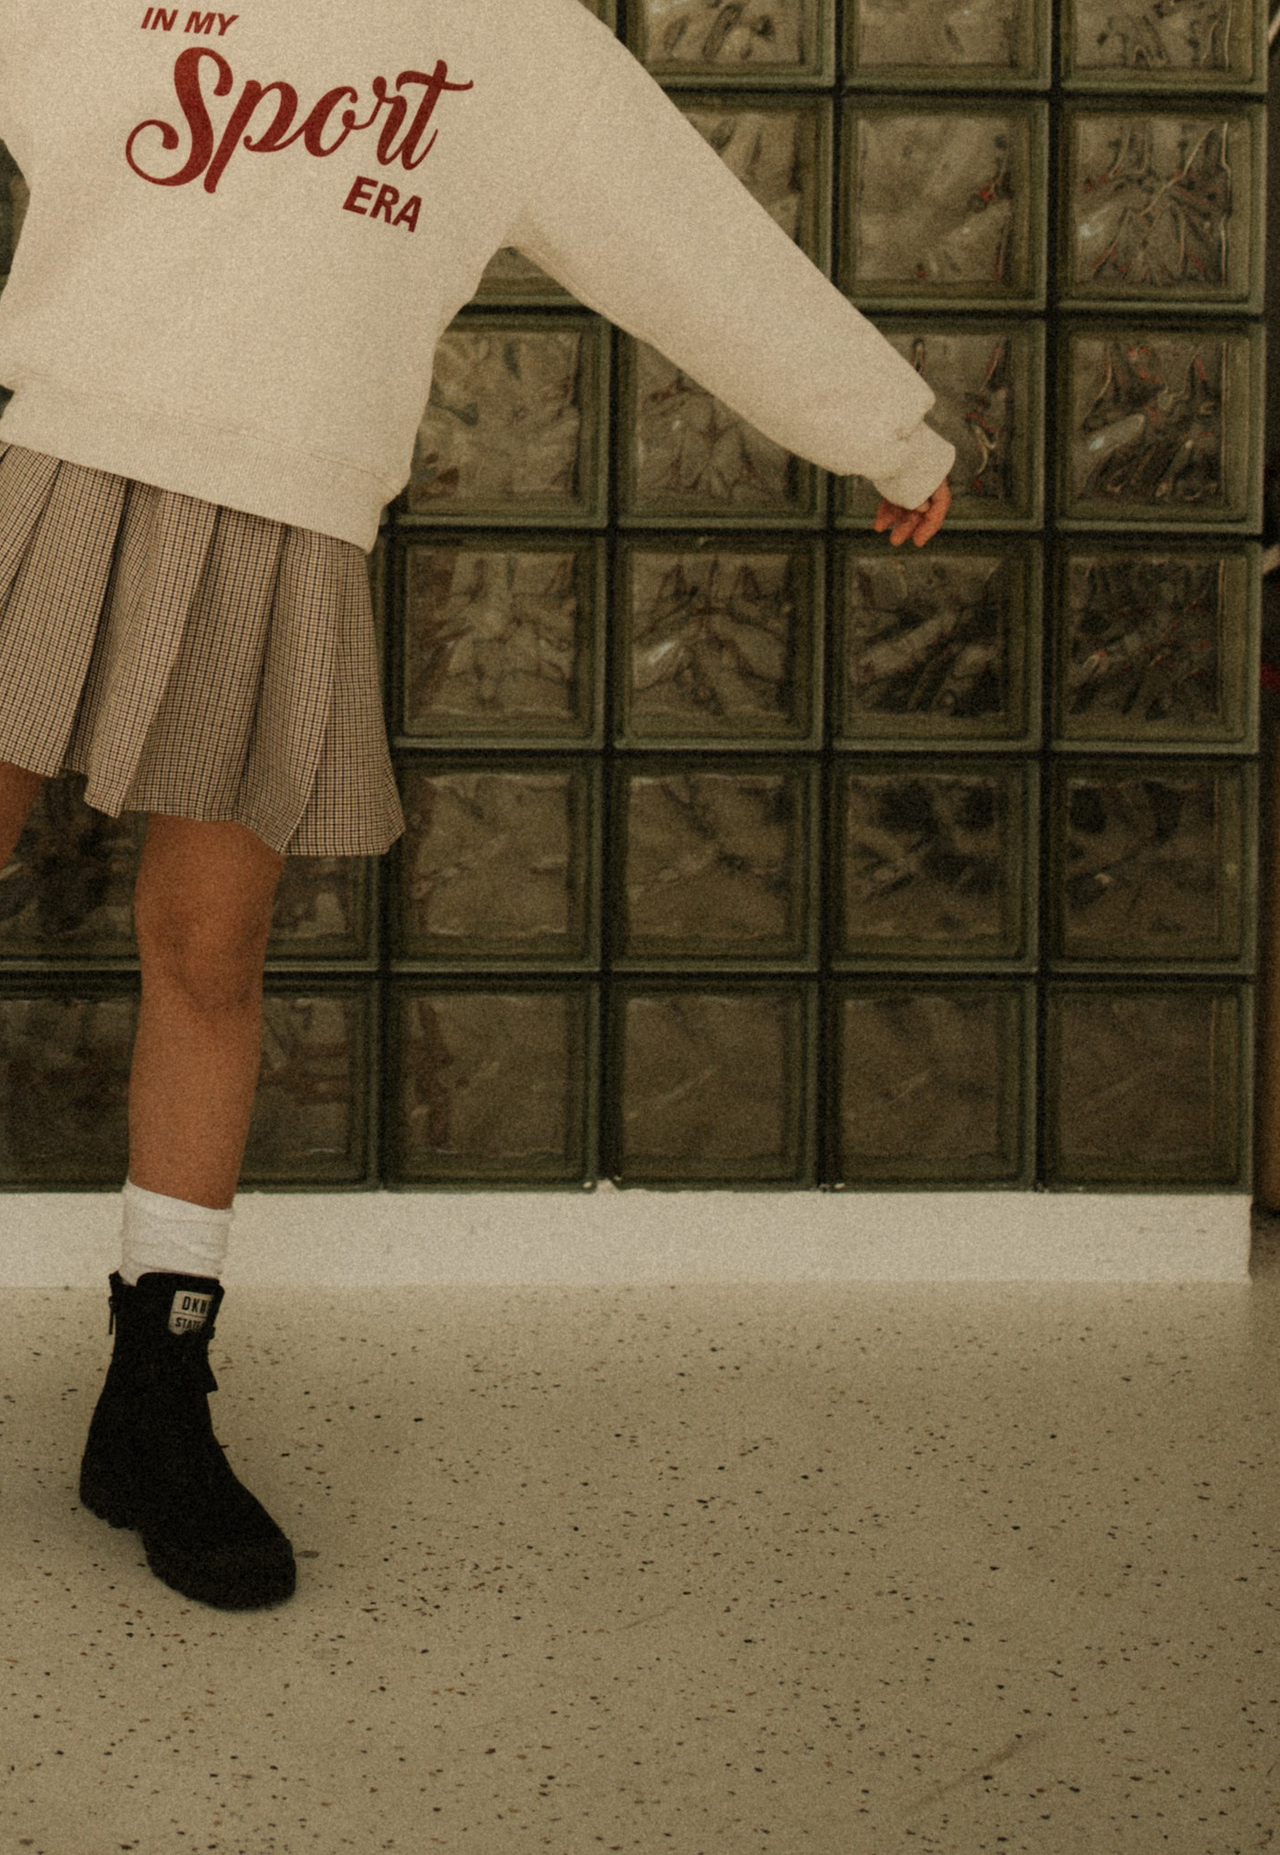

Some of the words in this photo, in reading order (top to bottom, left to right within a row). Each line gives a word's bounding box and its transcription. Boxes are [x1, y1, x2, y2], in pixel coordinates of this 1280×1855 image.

[140, 6, 178, 32] IN
[183, 10, 240, 37] MY
[124, 46, 475, 194] Sport
[342, 174, 423, 233] ERA
[182, 1295, 208, 1315] DKN
